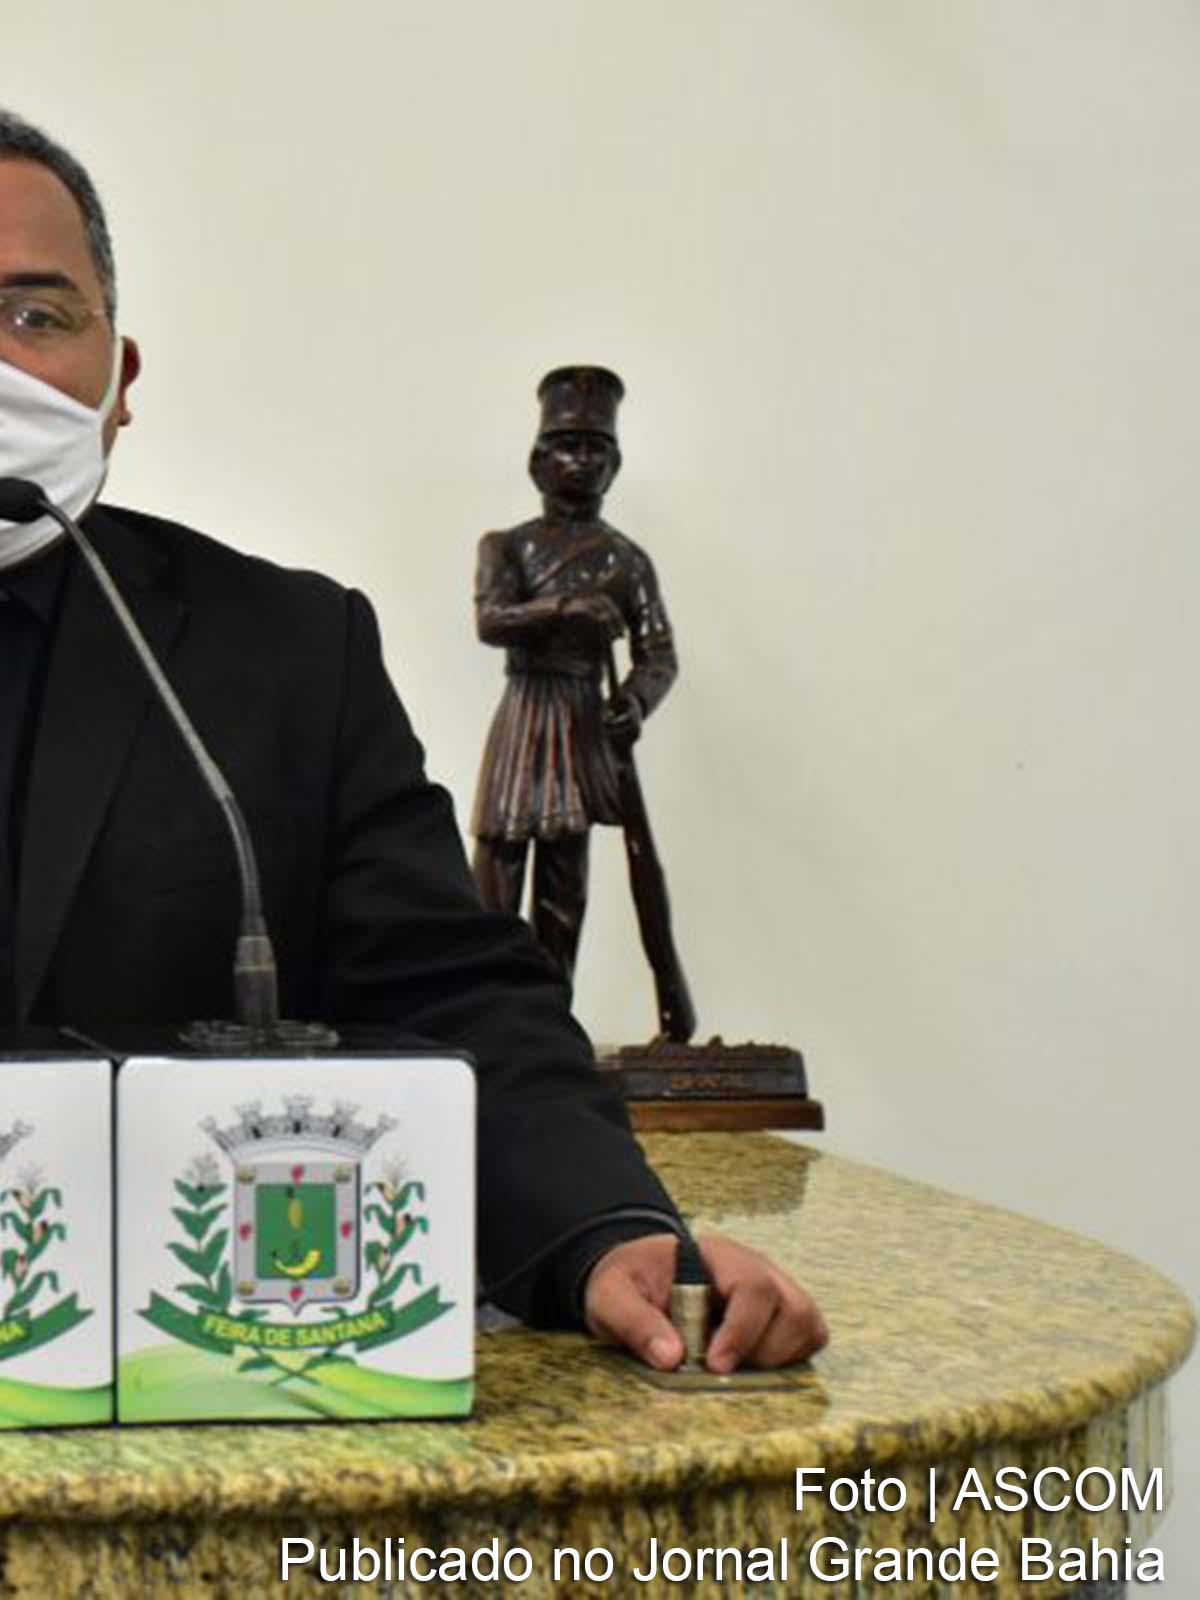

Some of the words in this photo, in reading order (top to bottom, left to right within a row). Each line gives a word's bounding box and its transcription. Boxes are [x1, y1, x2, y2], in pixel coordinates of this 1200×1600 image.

[202, 1314, 261, 1345] FEIRA
[264, 1327, 291, 1346] DE
[295, 1311, 387, 1346] SANTANA
